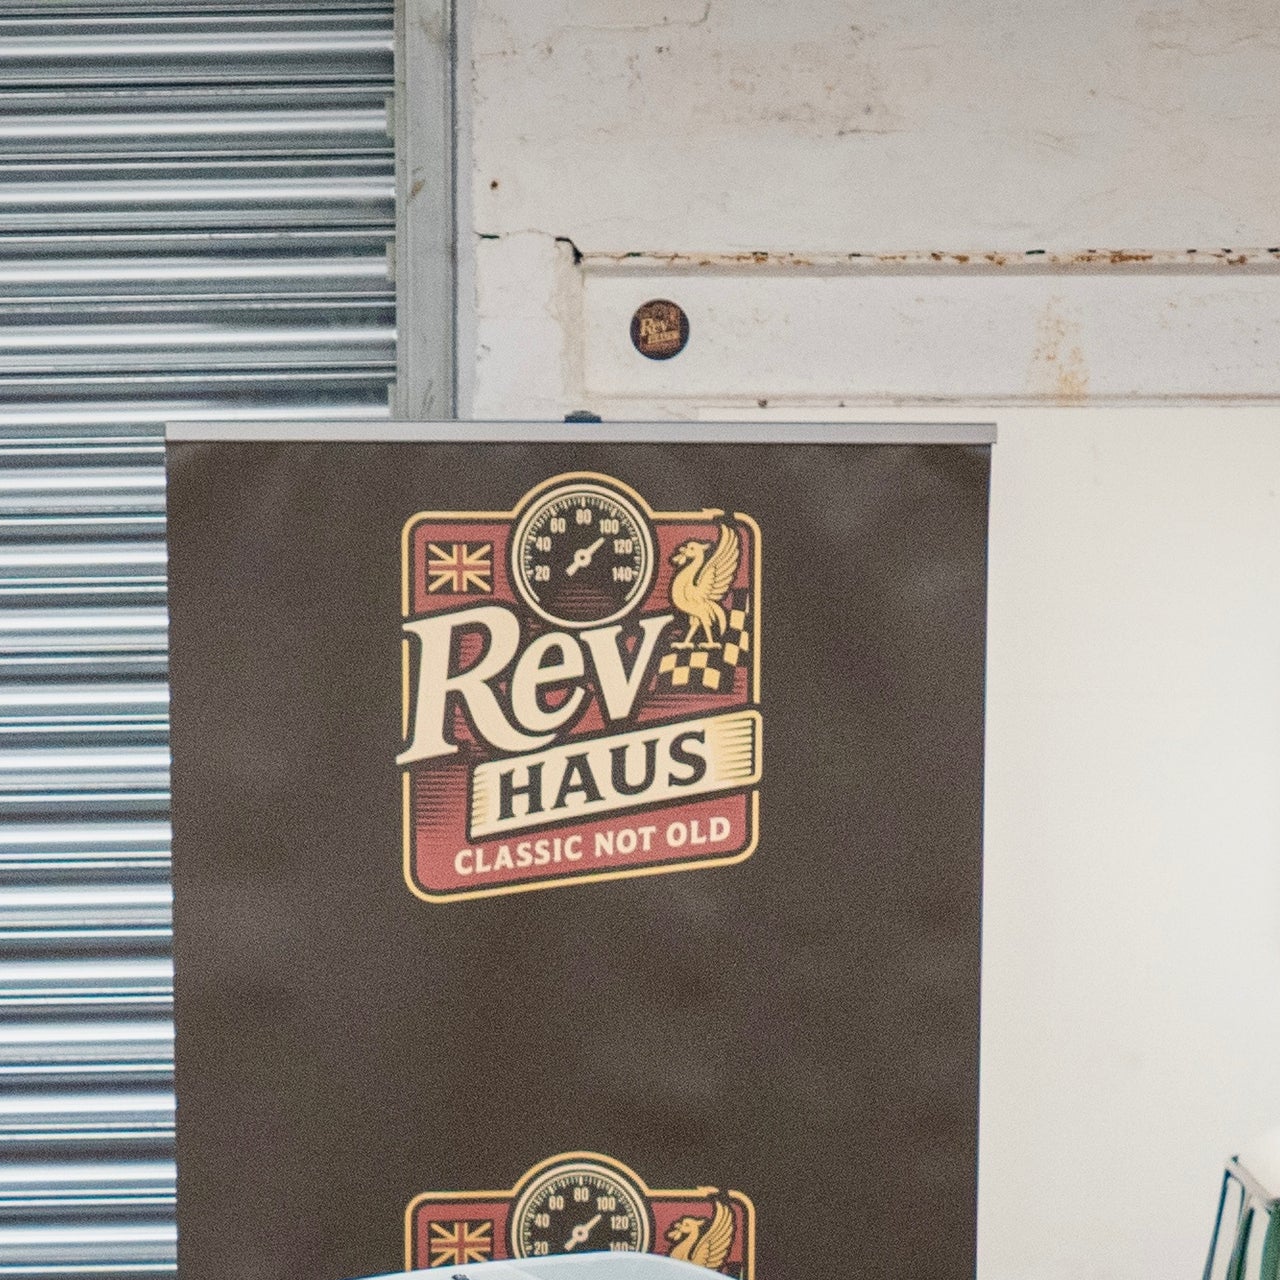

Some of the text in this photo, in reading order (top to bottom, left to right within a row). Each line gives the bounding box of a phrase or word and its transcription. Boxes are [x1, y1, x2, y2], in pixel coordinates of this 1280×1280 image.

[576, 510, 591, 524] 80
[550, 517, 566, 533] 60
[599, 517, 620, 534] 100
[535, 536, 551, 552] 40
[614, 539, 632, 554] 120
[535, 566, 550, 581] 20
[612, 566, 632, 582] 140
[396, 606, 673, 767] Rev
[497, 729, 707, 822] HAUS
[454, 816, 732, 877] CLASSIC NOT OLD
[573, 1187, 589, 1202] 80
[597, 1196, 616, 1211] 100
[535, 1214, 550, 1229] 40
[611, 1215, 629, 1230] 120
